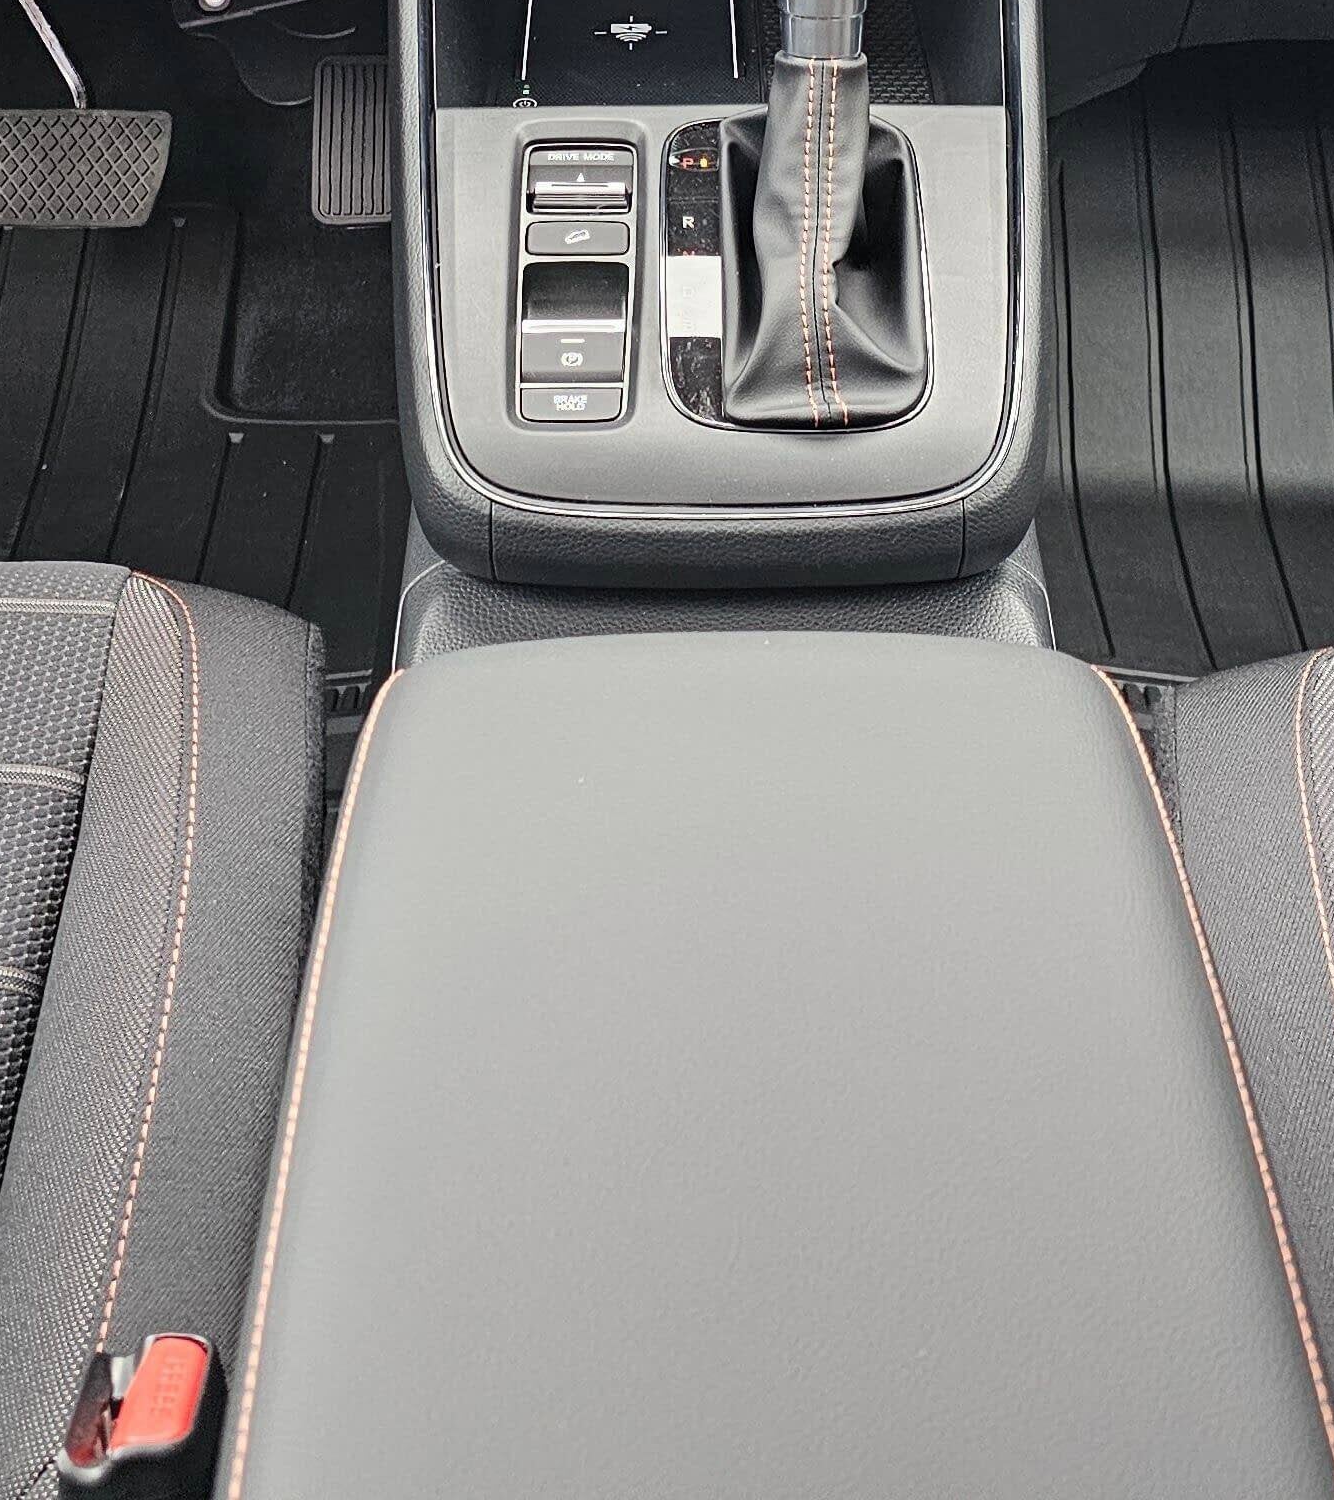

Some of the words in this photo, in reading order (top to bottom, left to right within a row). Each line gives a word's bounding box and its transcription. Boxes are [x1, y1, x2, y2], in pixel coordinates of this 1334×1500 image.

[548, 152, 579, 162] DRIVE
[583, 152, 615, 162] MODE
[682, 157, 695, 170] P
[682, 215, 695, 229] R
